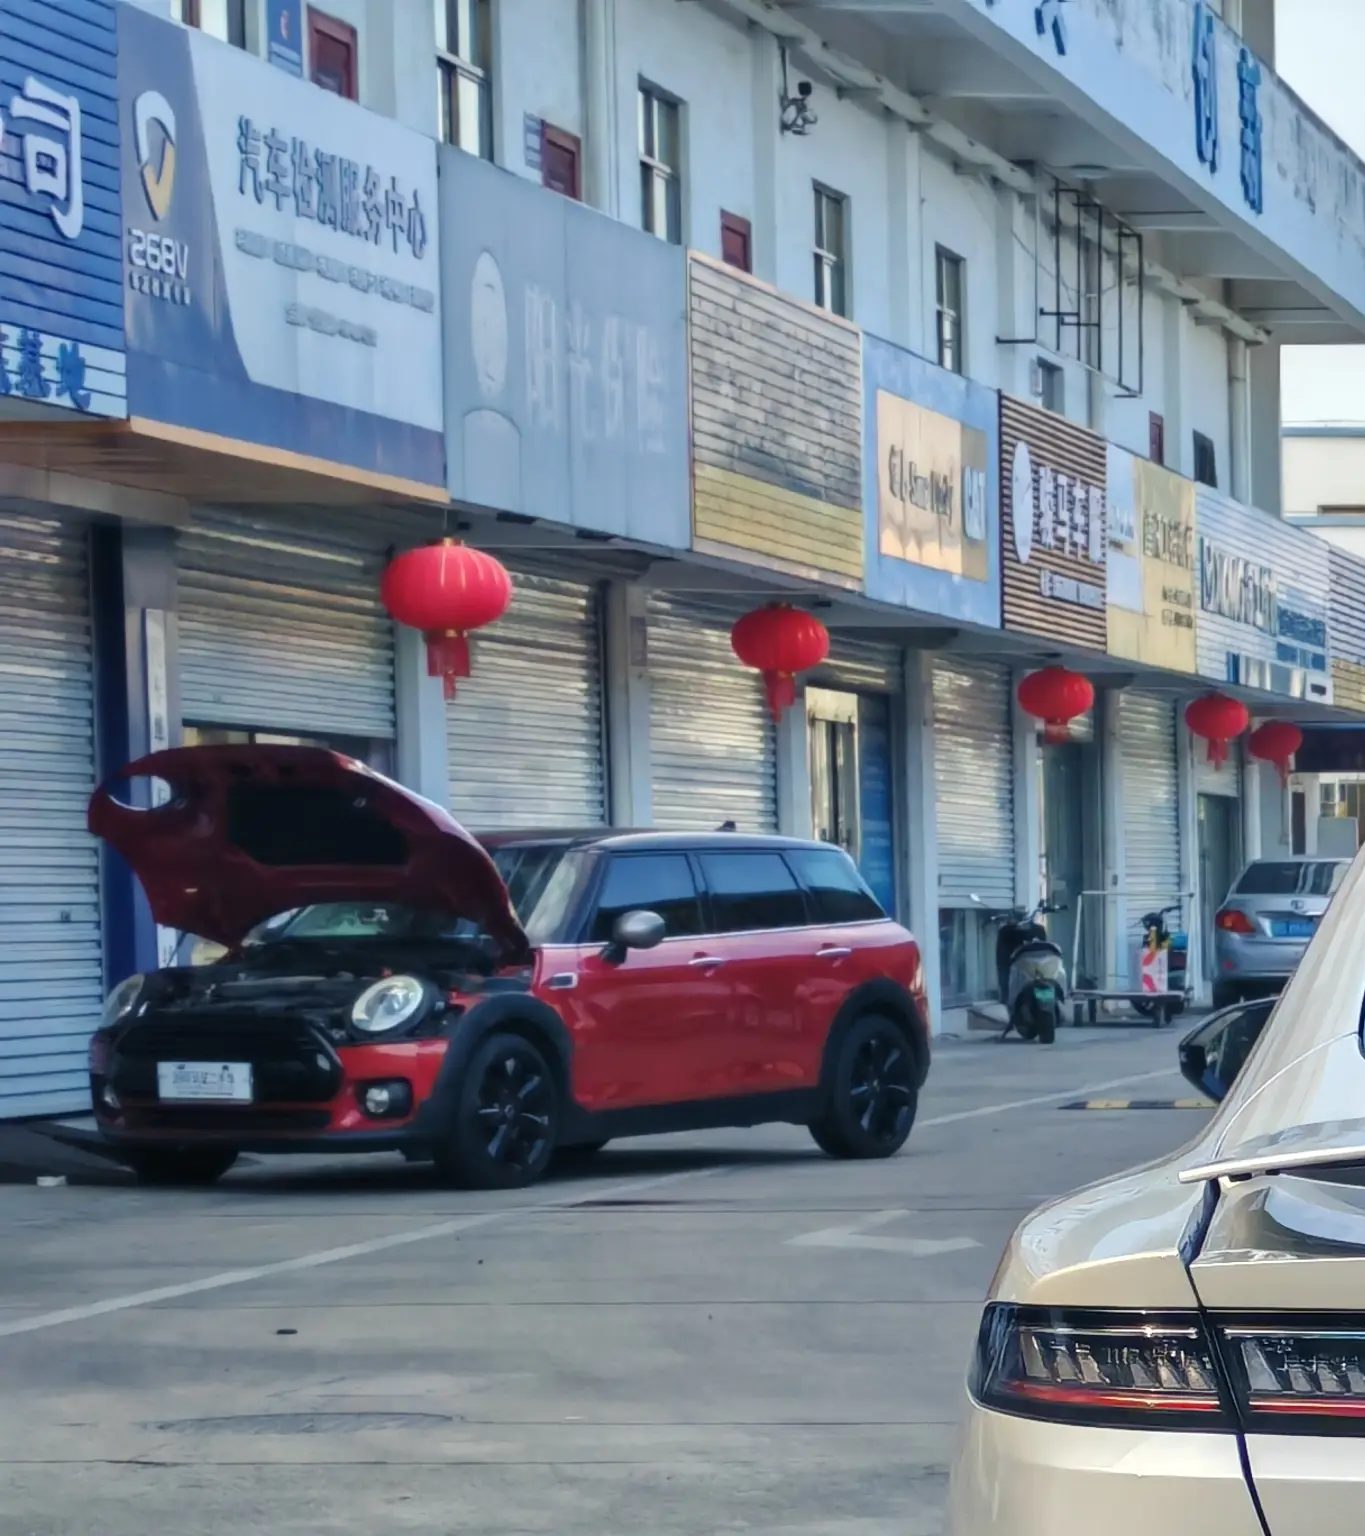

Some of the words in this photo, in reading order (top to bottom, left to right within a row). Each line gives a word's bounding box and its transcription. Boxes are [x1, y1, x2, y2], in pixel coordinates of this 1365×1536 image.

[0, 75, 84, 240] 司
[237, 115, 428, 260] 汽车检测服务中心
[127, 228, 189, 280] 268V
